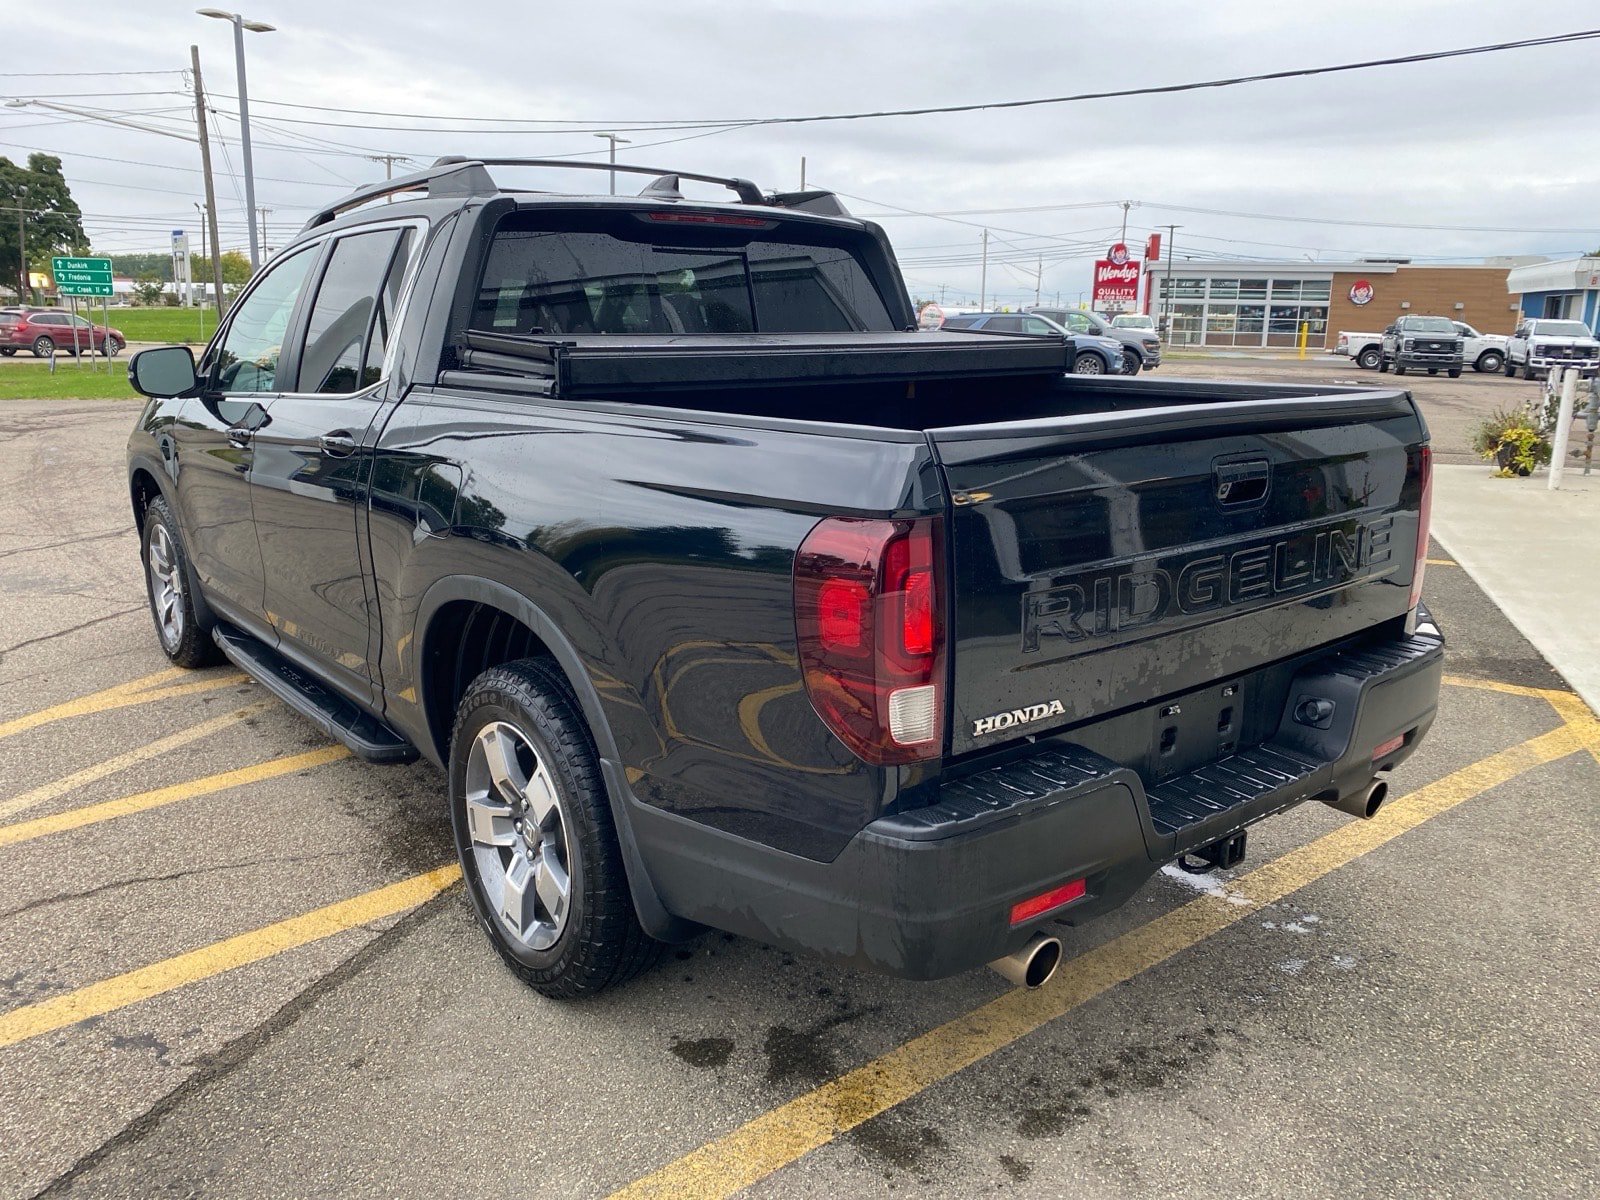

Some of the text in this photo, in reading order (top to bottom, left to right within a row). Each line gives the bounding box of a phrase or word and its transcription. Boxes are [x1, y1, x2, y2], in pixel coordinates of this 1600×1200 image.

[67, 261, 109, 270] Dunkirk 2
[68, 273, 91, 281] Fredonia
[1098, 264, 1138, 282] Wendy's
[59, 285, 74, 293] Silver
[77, 286, 92, 294] Creek
[1021, 516, 1394, 654] RIDGELINE
[972, 699, 1066, 737] HONDA
